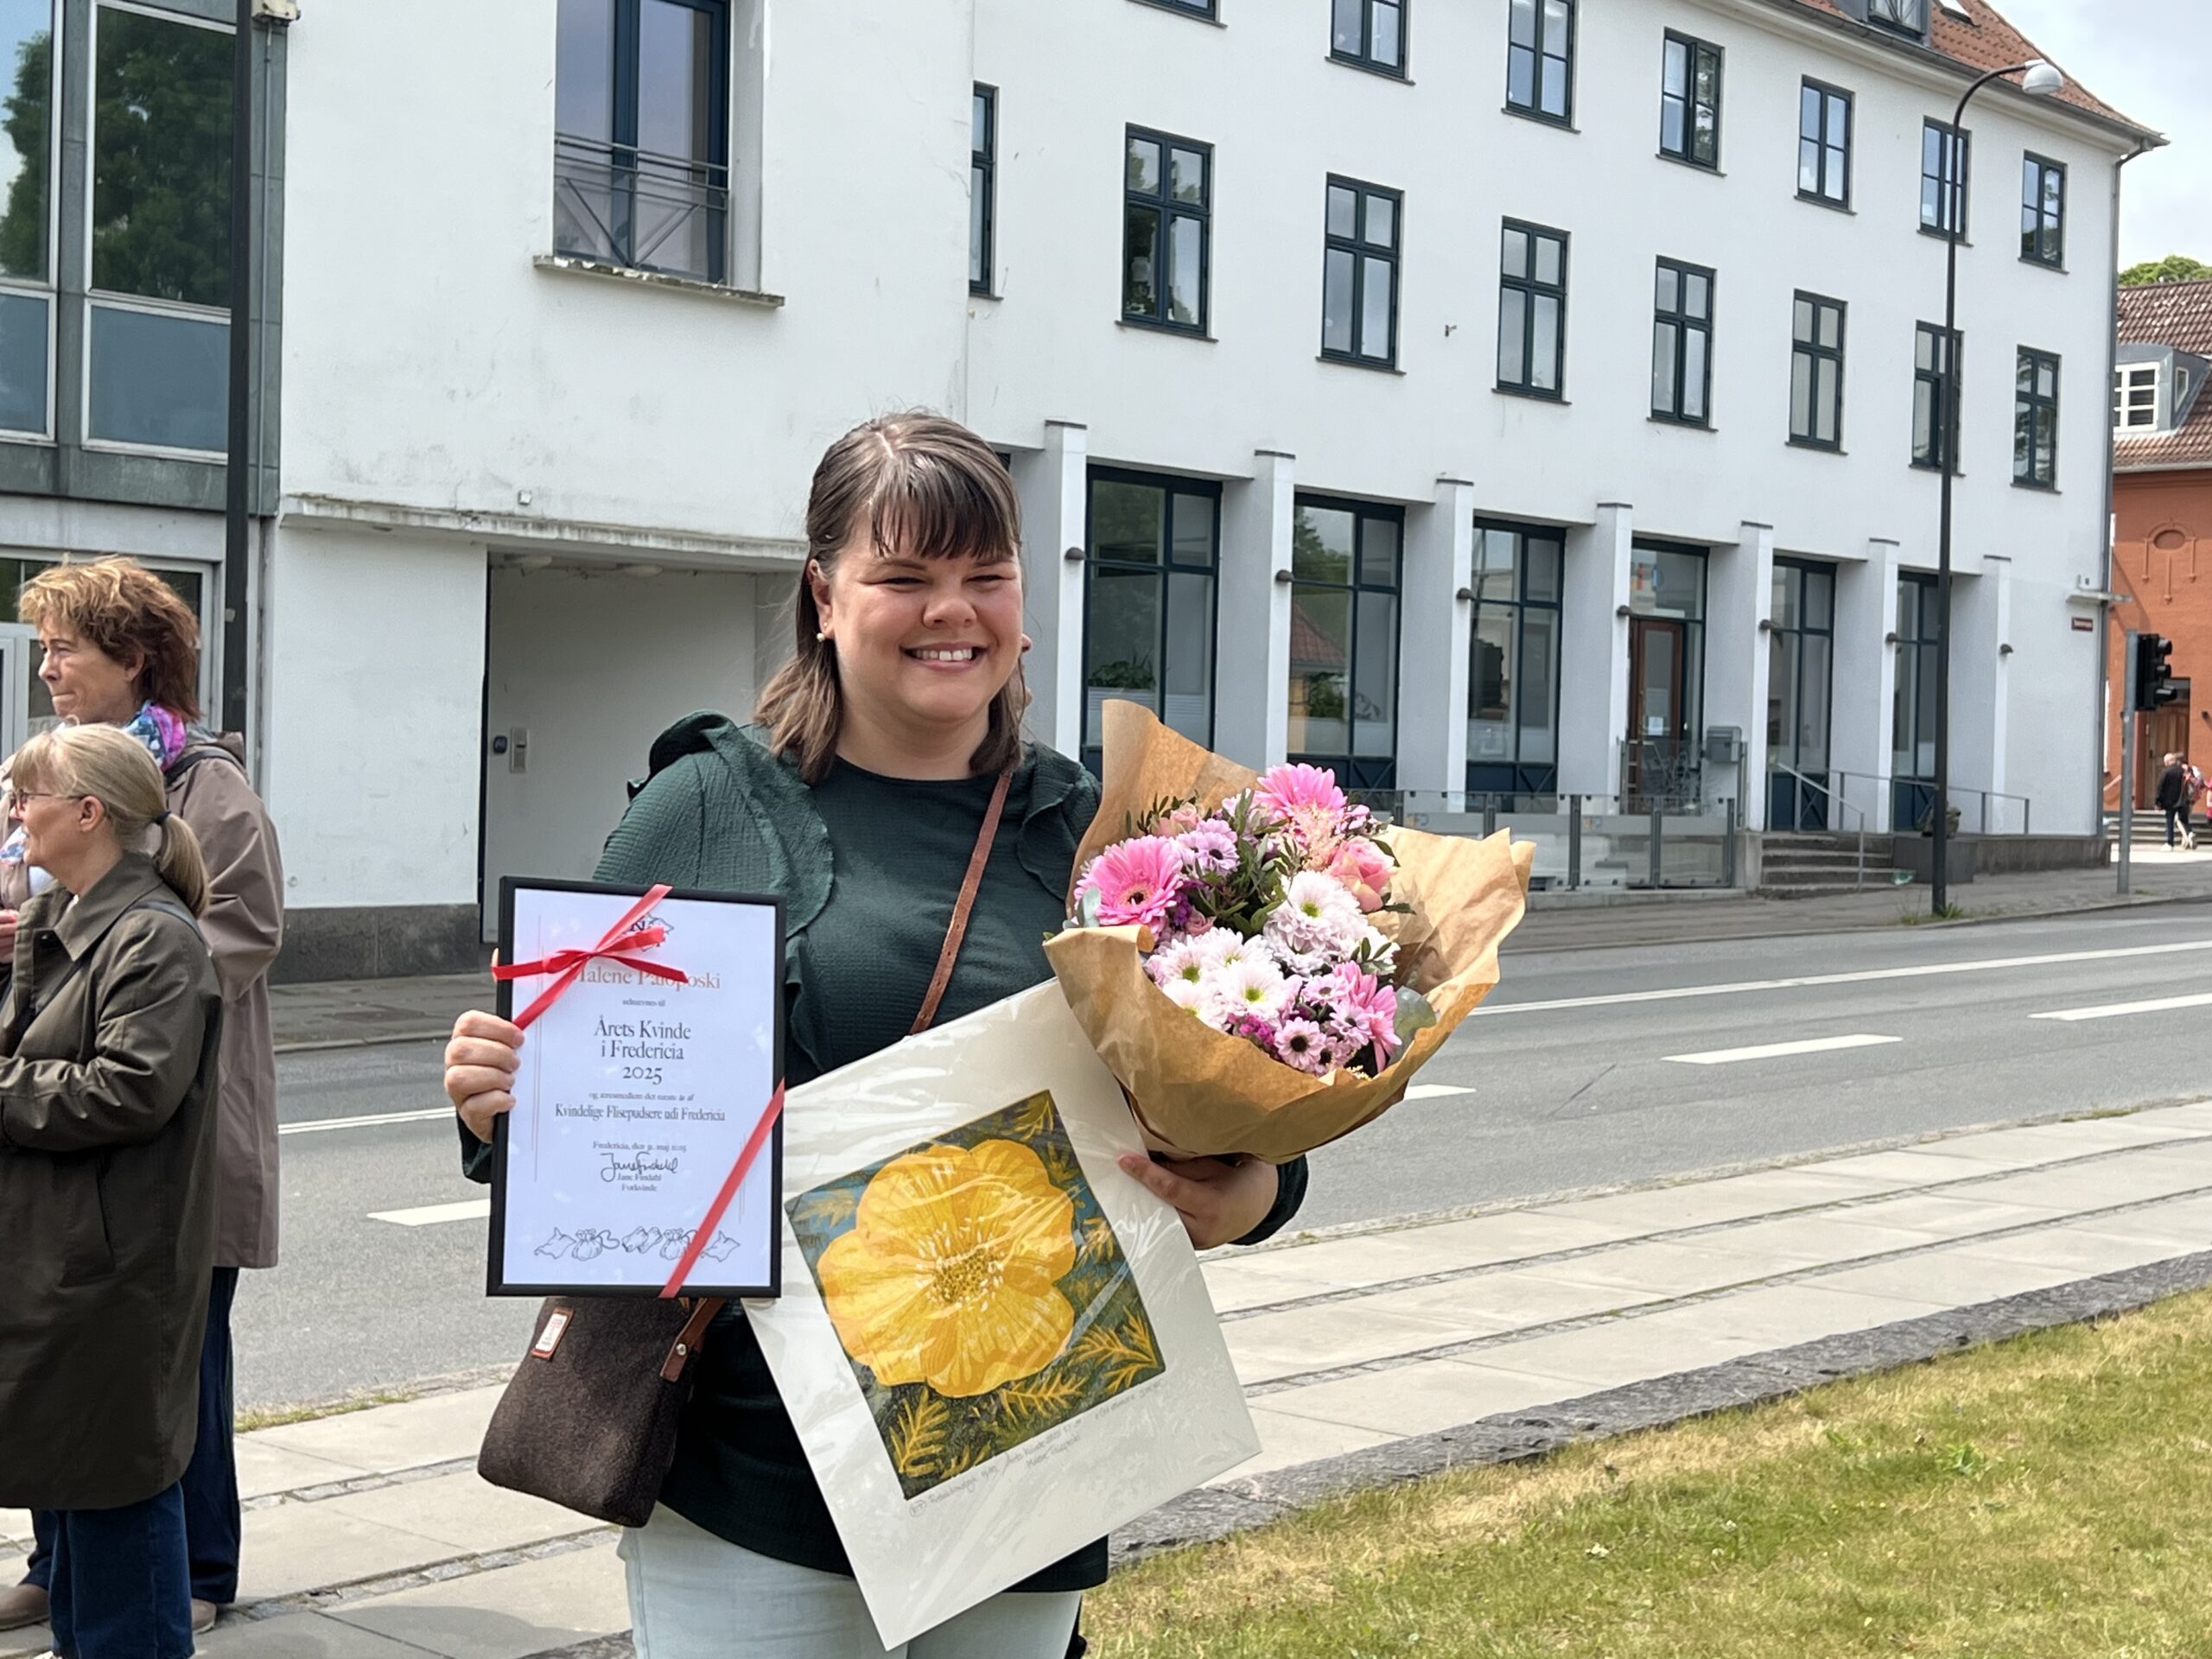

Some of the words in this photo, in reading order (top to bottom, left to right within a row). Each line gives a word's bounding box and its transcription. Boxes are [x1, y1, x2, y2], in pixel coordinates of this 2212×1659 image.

[594, 1014, 635, 1037] Årets
[639, 1020, 691, 1039] Kvinde
[601, 1039, 606, 1057] i
[610, 1039, 684, 1060] Fredericia
[622, 1066, 663, 1085] 2025
[556, 1103, 604, 1120] Kvindelige
[607, 1104, 663, 1122] Flisepudsere
[681, 1108, 726, 1122] Fredericia
